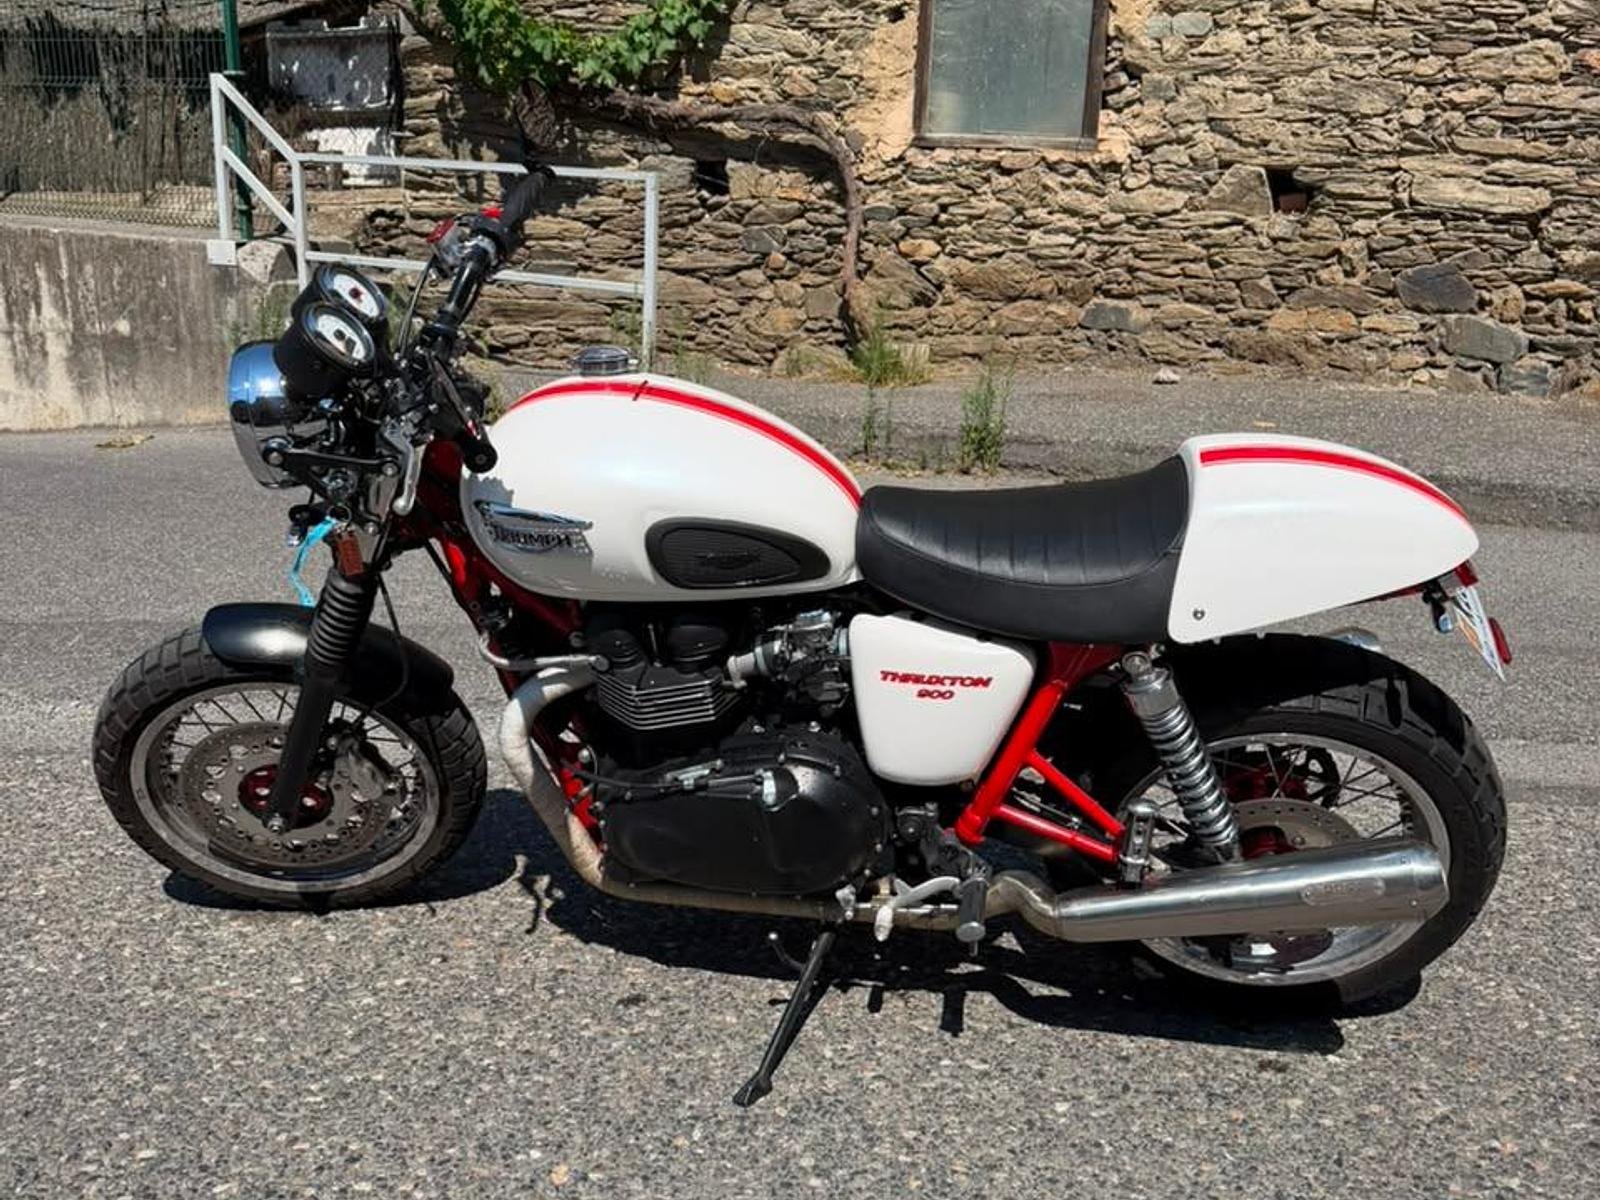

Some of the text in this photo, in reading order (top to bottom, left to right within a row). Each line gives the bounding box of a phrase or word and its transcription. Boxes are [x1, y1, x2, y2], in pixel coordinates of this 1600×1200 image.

[490, 523, 573, 548] TRIUMPH
[880, 670, 993, 688] THRUXTON
[917, 689, 955, 699] 900
